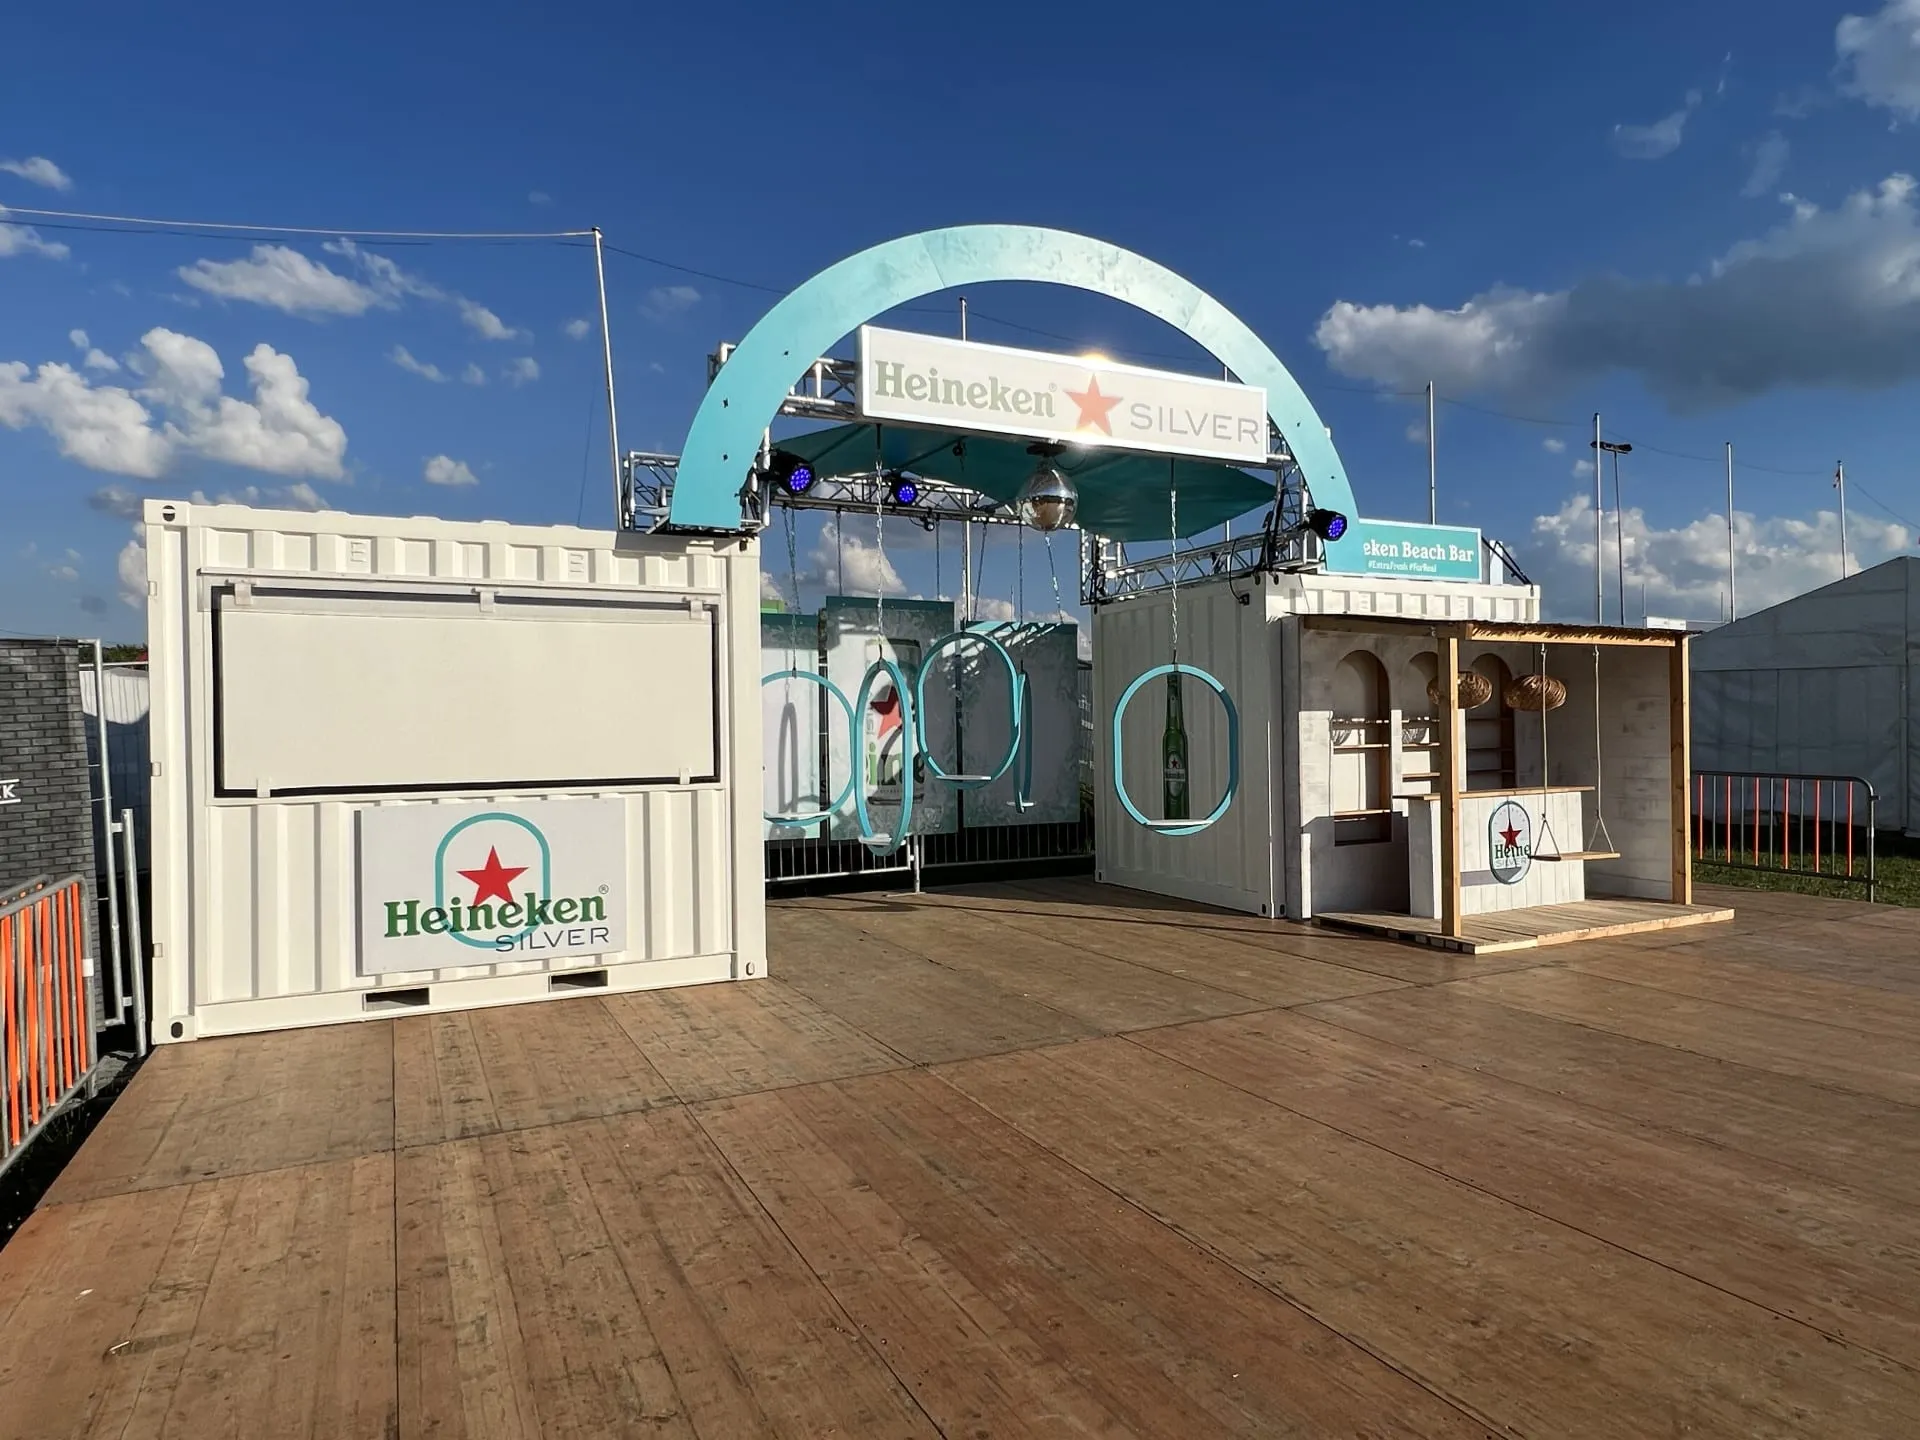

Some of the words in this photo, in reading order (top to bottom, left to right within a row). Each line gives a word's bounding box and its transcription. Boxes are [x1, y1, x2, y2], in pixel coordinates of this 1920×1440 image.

[874, 359, 1056, 419] Heineken
[1129, 402, 1260, 445] SILVER
[1401, 540, 1446, 560] Beach
[1448, 543, 1474, 562] Bar
[0, 784, 16, 799] K
[383, 892, 607, 938] Heineken
[495, 927, 609, 952] SILVER
